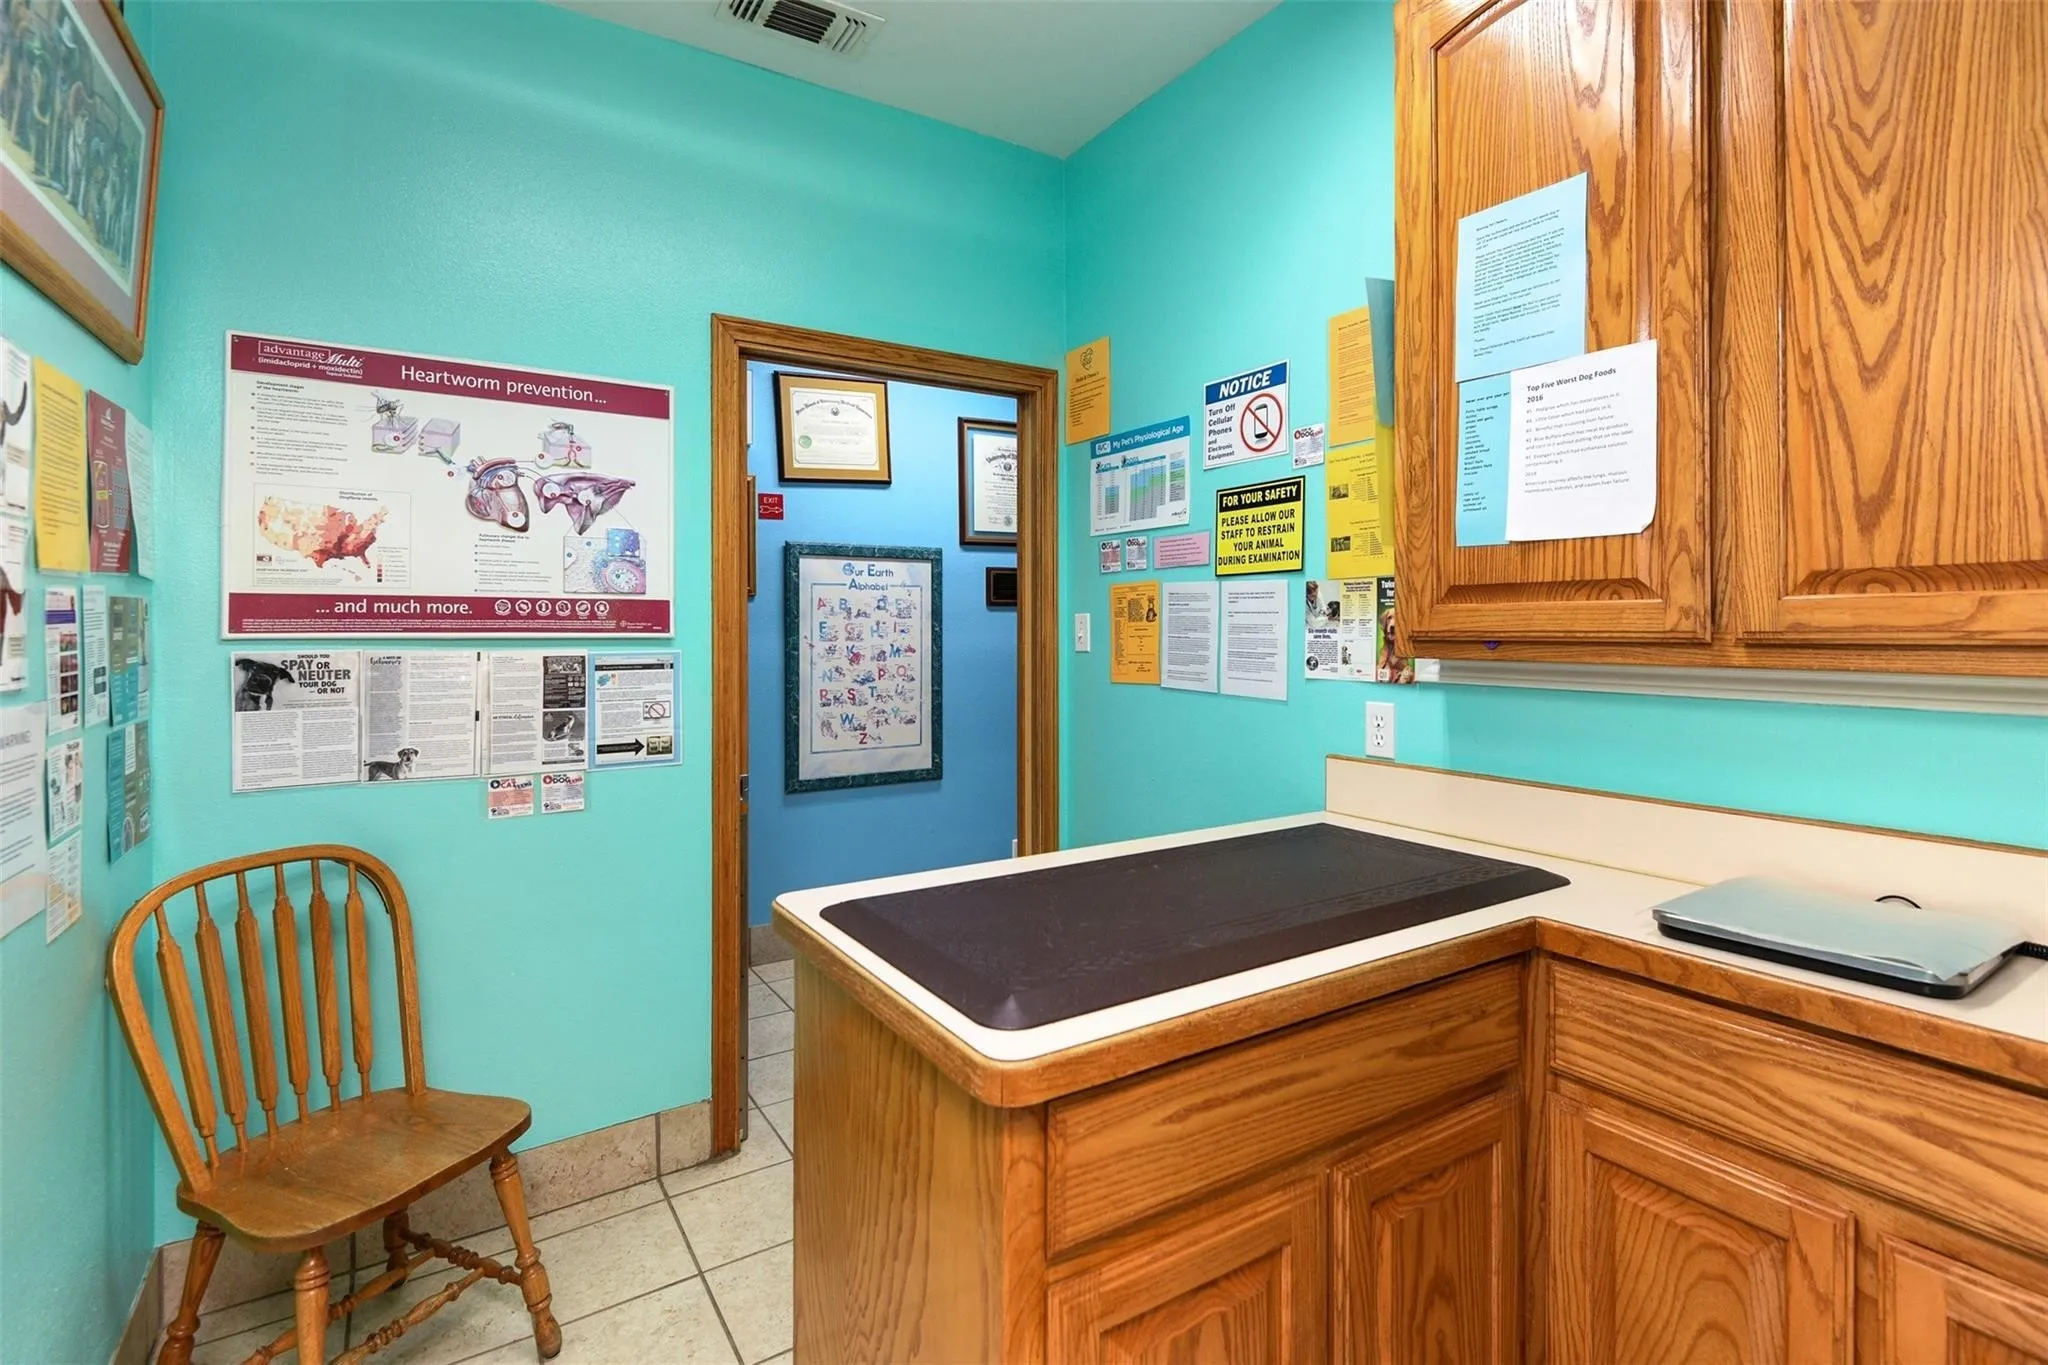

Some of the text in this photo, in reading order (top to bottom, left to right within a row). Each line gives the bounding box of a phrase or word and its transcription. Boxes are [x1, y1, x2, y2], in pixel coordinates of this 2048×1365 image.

[263, 344, 325, 361] advantage
[320, 351, 364, 368] Multi
[258, 356, 310, 370] (imidacloprid
[319, 365, 363, 376] moxidectin)
[401, 365, 500, 391] Heartworm
[1219, 369, 1272, 399] NOTICE
[1526, 368, 1617, 393] Top Five Worst Dog Foods
[1526, 394, 1544, 404] 2016
[1208, 403, 1236, 417] Turn Off
[1208, 416, 1233, 427] Cellular
[1112, 440, 1121, 449] My
[1134, 427, 1171, 443] Physiological
[1172, 425, 1184, 434] Age
[1208, 427, 1233, 437] Phones
[1208, 444, 1233, 453] Electronic
[1208, 450, 1235, 461] Equipment
[763, 496, 779, 504] EXIT
[1222, 485, 1297, 508] FOR YOUR SAFETY
[1221, 508, 1295, 527] PLEASE ALLOW OUR
[1221, 522, 1295, 541] STAFF TO RESTRAIN
[1233, 538, 1284, 552] YOUR ANIMAL
[1218, 550, 1300, 566] DURING EXAMINATION
[867, 564, 894, 577] Earth
[848, 578, 888, 591] Alphabet
[334, 599, 367, 614] and
[374, 600, 420, 614] much
[427, 602, 473, 615] more.
[280, 660, 330, 671] SPAY OR
[298, 669, 351, 681] NEUTER
[859, 732, 868, 744] Z
